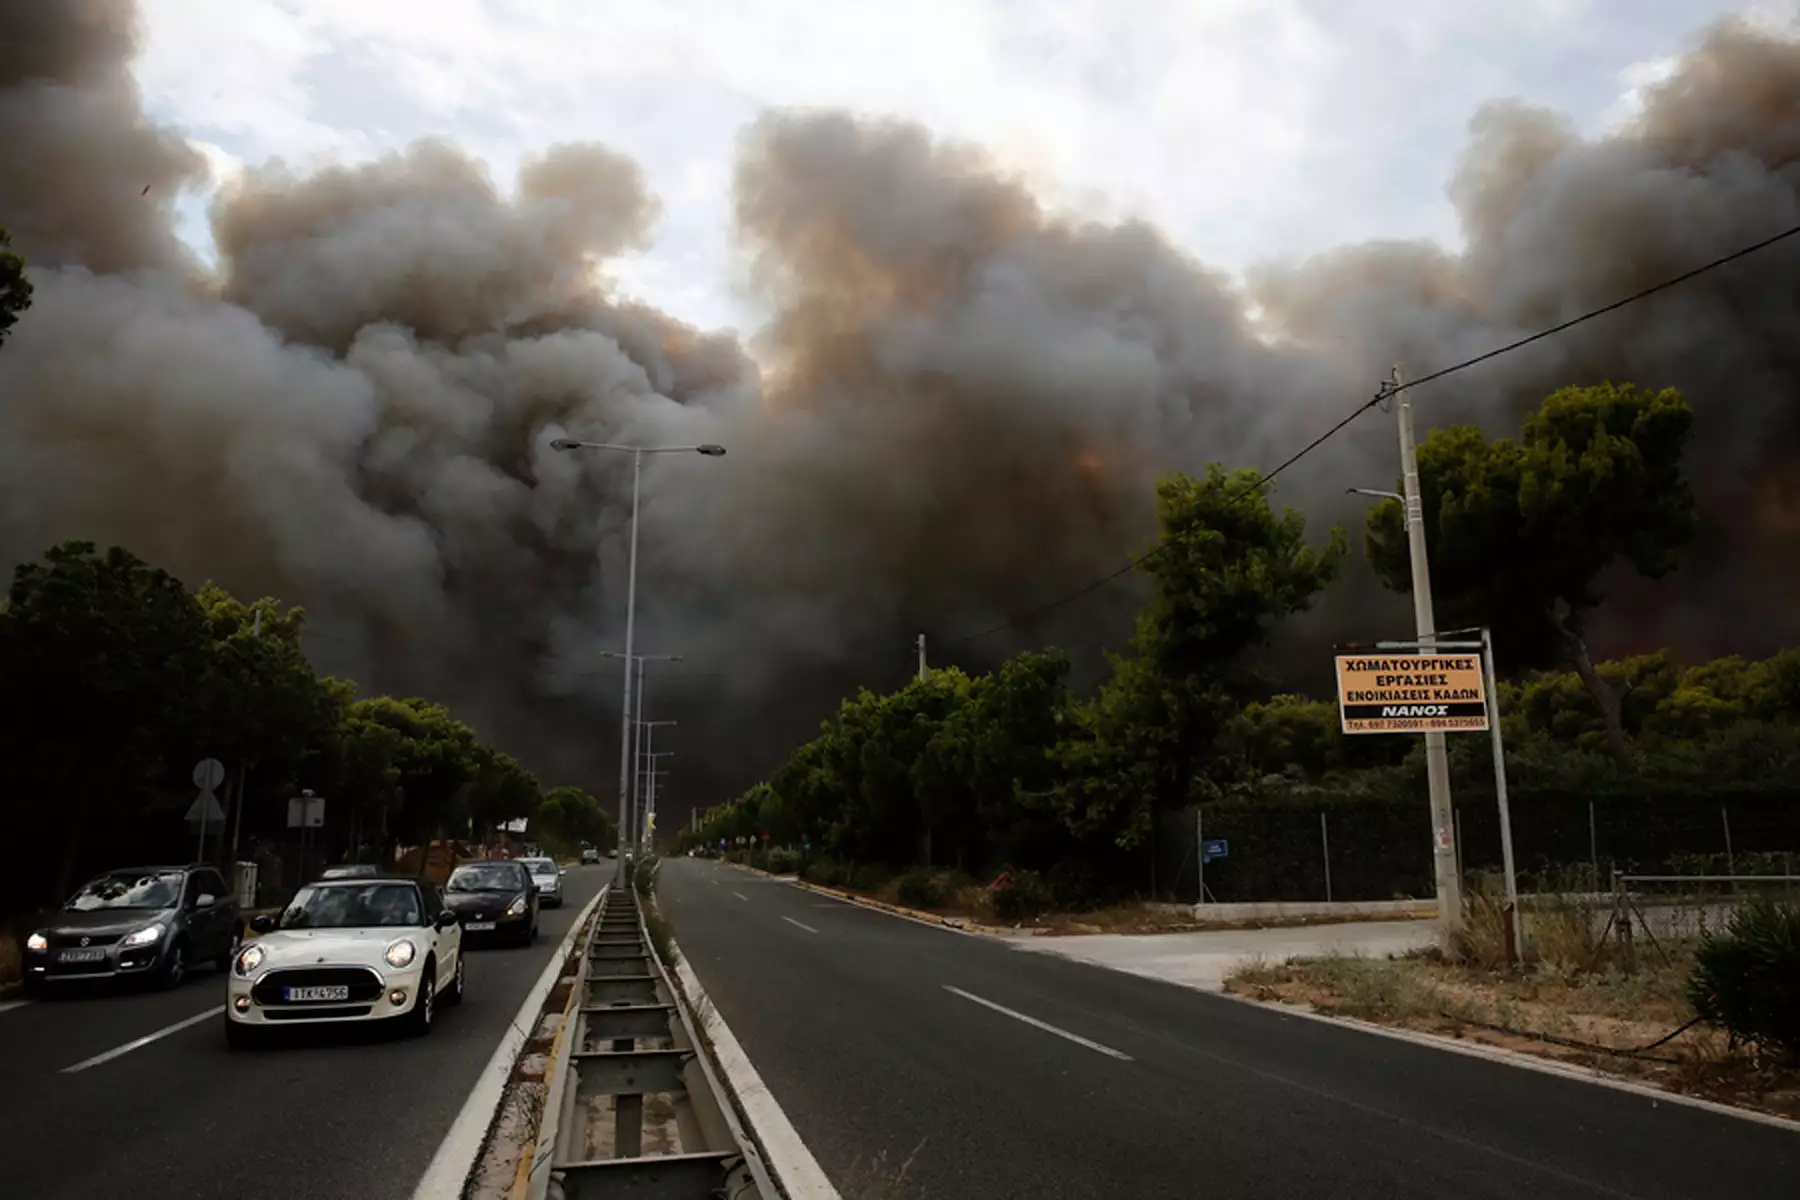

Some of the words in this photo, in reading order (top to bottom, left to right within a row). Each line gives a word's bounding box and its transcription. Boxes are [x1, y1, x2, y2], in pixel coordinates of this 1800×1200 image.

[1345, 659, 1475, 671] ΧΩΜΑΤΟΥΡΓΙΚΕΣ
[1375, 674, 1449, 687] ΕΡΓΑΣΙΕΣ
[1347, 689, 1431, 702] ΕΝΟΙΚΙΑΣΕΙΣ
[1433, 688, 1479, 700] ΚΑΔΩΝ
[1381, 705, 1449, 717] ΝΑΝΟΣ
